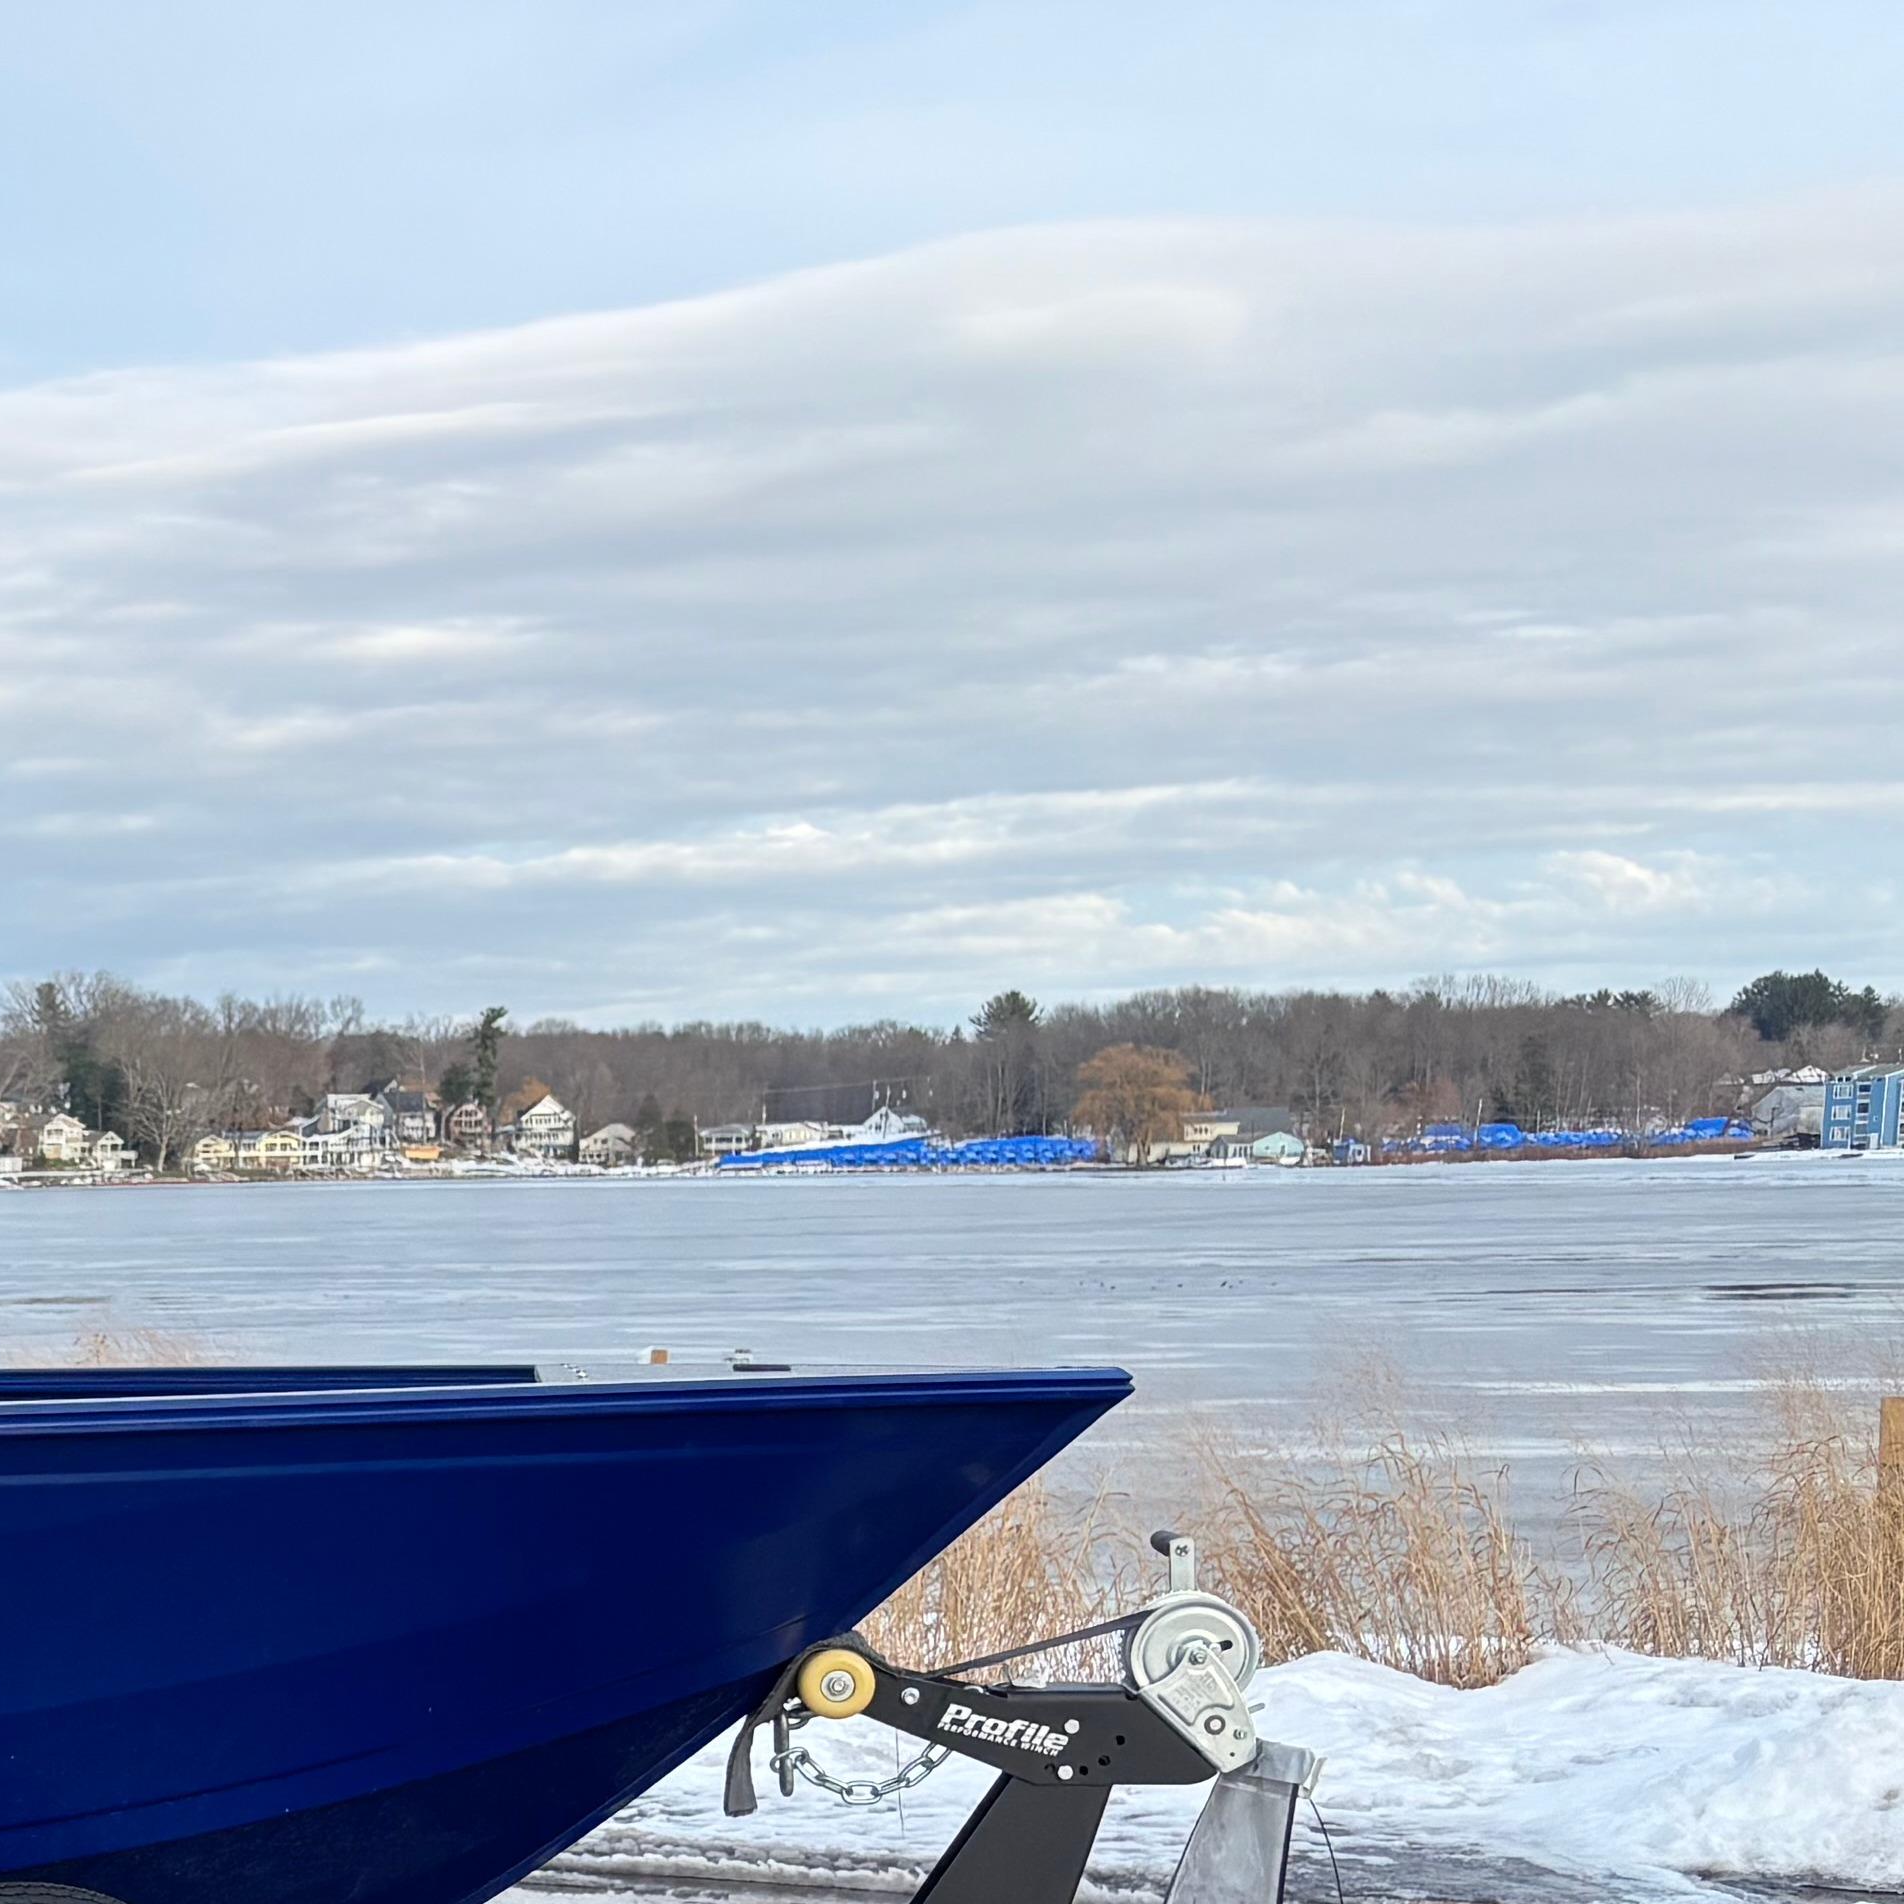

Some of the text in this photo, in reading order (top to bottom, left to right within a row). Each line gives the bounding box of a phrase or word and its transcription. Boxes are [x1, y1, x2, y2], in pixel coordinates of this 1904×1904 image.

[937, 1721, 1060, 1757] PERFORMANCE WINCH
[941, 1703, 1069, 1751] Profile
